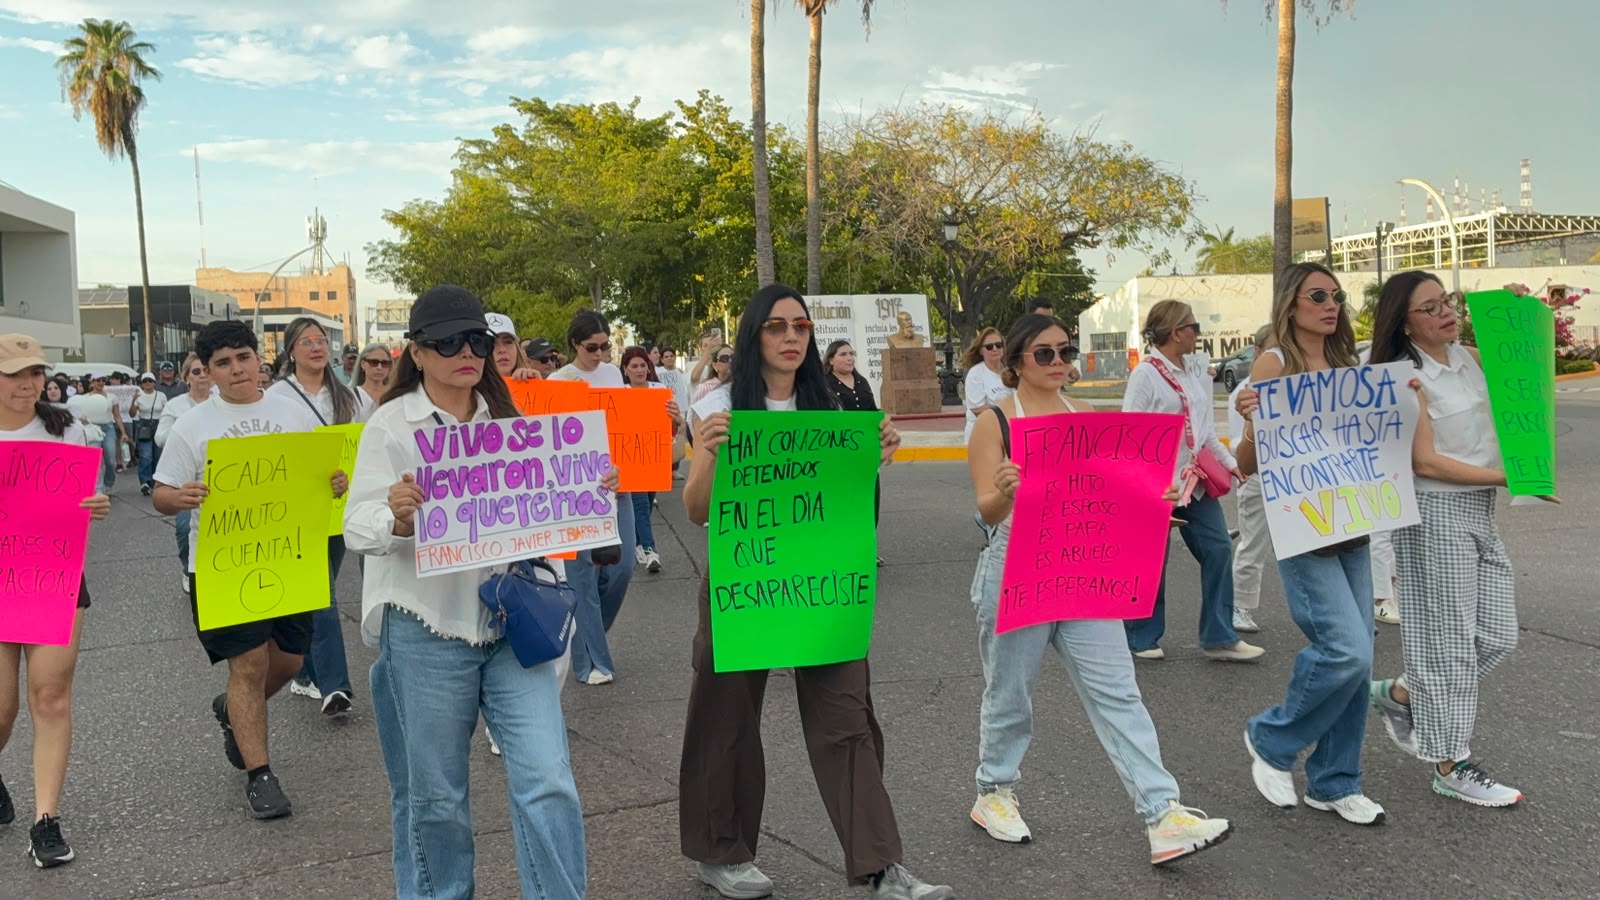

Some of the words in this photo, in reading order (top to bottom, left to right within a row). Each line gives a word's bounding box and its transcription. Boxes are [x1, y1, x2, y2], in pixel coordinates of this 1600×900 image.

[1252, 378, 1281, 420] TE
[608, 430, 671, 466] TRARTE
[727, 428, 764, 466] HAY
[1024, 423, 1179, 479] FRANCISCO
[1257, 415, 1329, 465] BUSCAR
[1333, 410, 1403, 447] HASTA
[207, 454, 288, 496] ¡CADA
[732, 458, 822, 488] DETENIDOS
[1261, 447, 1385, 503] ENCONTRARTE
[1508, 455, 1528, 478] TE
[1046, 479, 1062, 502] ES
[207, 501, 288, 537] MINUTO
[456, 485, 612, 543] queremos
[718, 500, 748, 536] EN
[757, 498, 781, 529] EL
[1041, 503, 1057, 525] ES
[1062, 500, 1121, 518] ESPOSO
[0, 535, 45, 557] ADES
[53, 538, 75, 561] SU
[212, 525, 303, 573] CUENTA!
[415, 543, 503, 571] FRANCISCO
[509, 533, 552, 554] JAVIER
[557, 525, 600, 545] IBARRA
[603, 520, 614, 536] R
[734, 536, 776, 569] QUE
[1039, 527, 1055, 546] ES
[1036, 550, 1053, 571] ES
[1060, 543, 1121, 566] ABUELO
[715, 570, 870, 613] DESAPARECISTE
[1004, 583, 1029, 615] ¡TE
[1036, 575, 1140, 604] ESPERAMOS!
